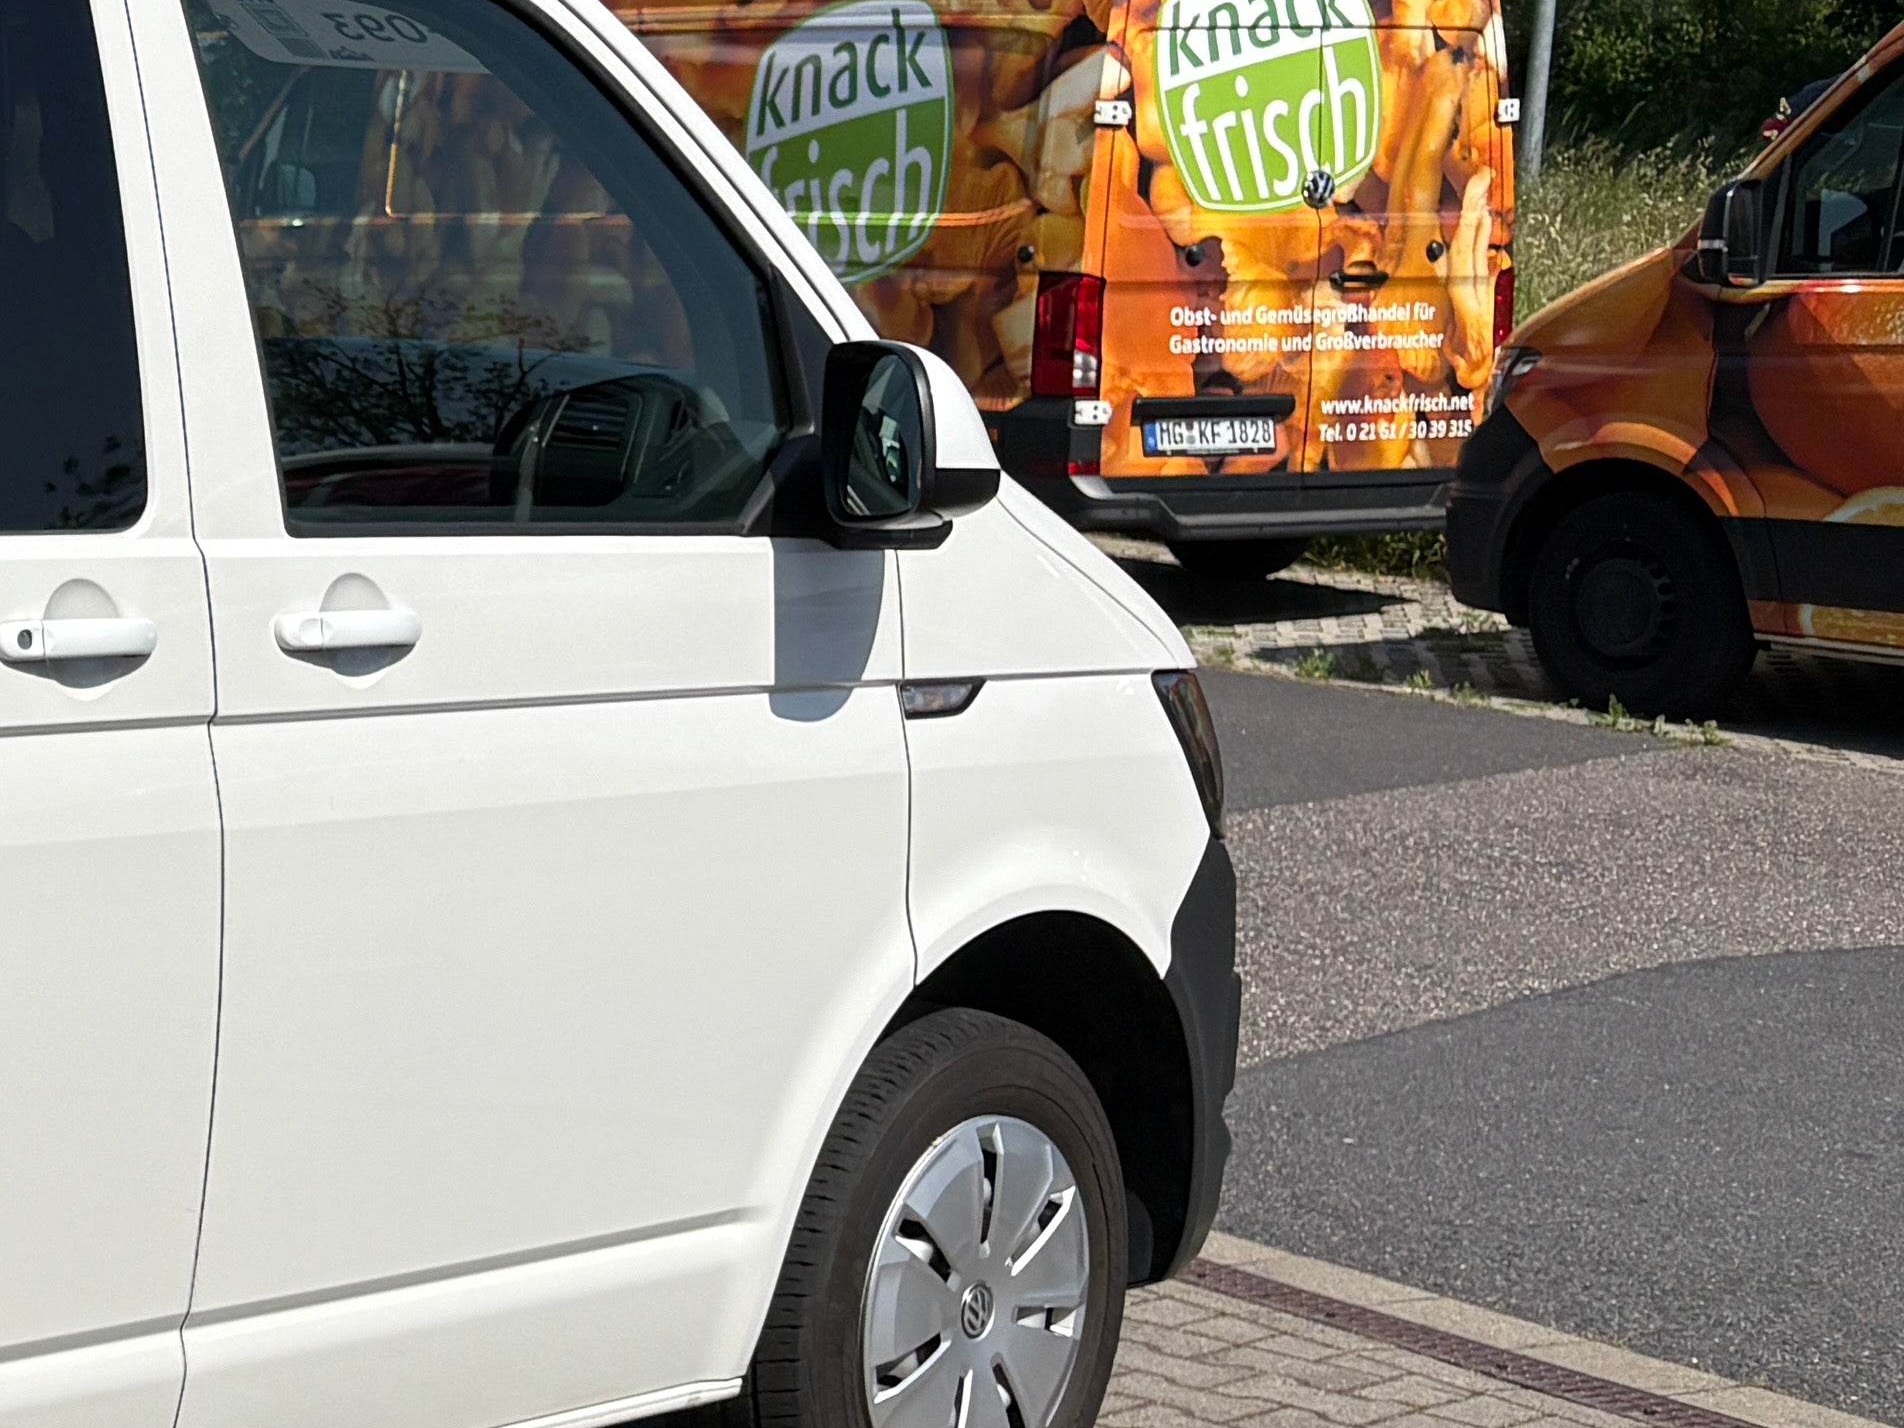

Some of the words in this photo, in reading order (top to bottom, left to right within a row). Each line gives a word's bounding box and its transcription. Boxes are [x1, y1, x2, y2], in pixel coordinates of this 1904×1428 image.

[757, 8, 933, 136] knack
[1180, 45, 1367, 201] frisch
[1169, 305, 1218, 327] Obst-
[1220, 306, 1254, 326] und
[1255, 302, 1411, 328] Gemüsegroßhandel
[1413, 301, 1437, 321] für
[1168, 333, 1279, 354] Gastronomie
[1281, 331, 1312, 352] und
[1315, 329, 1445, 351] Großverbraucher
[1320, 391, 1476, 416] www.knackfrisch.net
[1198, 420, 1222, 445] KF
[1227, 419, 1272, 445] 1828
[1318, 422, 1343, 443] Tel.
[1345, 422, 1358, 442] 0
[1358, 421, 1377, 442] 21
[1378, 420, 1397, 441] 61
[1397, 420, 1409, 441] /
[1407, 419, 1428, 440] 30
[1428, 419, 1448, 439] 39
